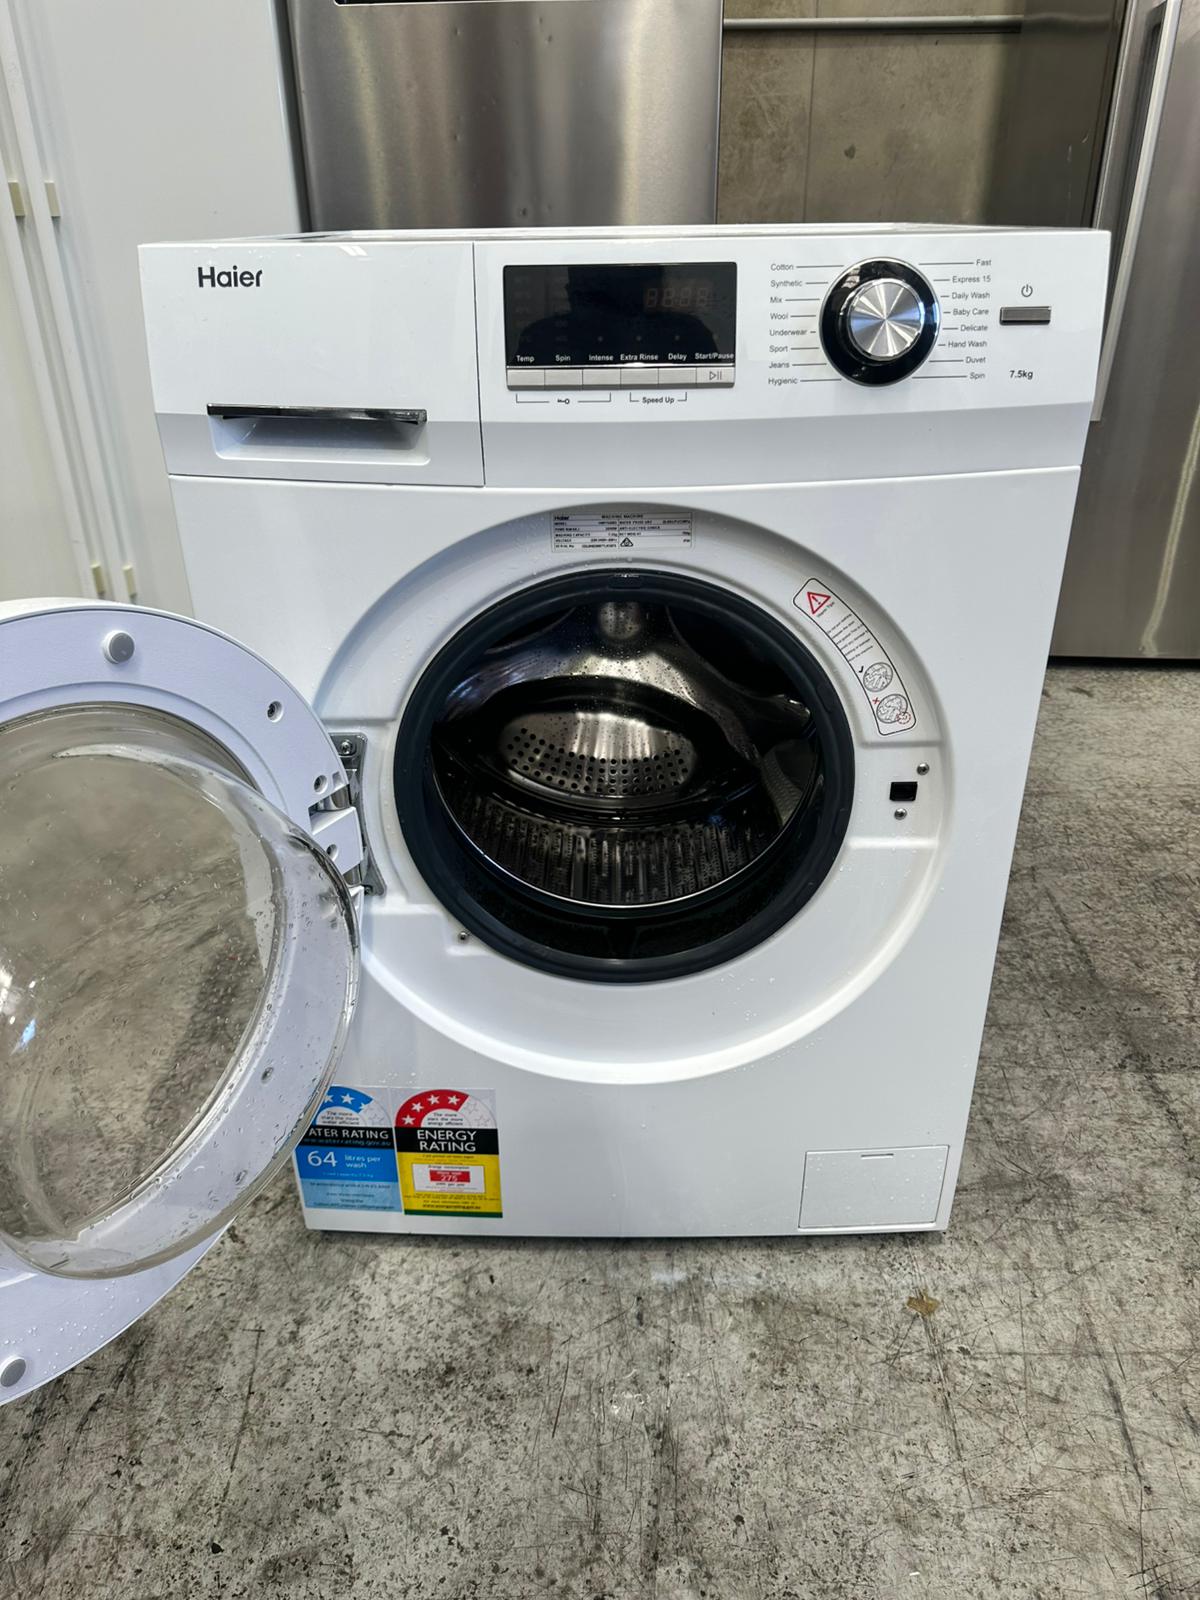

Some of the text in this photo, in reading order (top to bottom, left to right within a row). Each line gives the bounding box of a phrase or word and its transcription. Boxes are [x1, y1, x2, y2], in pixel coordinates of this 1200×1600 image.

[770, 263, 794, 271] Cotton
[976, 259, 992, 267] Fast
[197, 265, 263, 288] Haier
[952, 275, 991, 284] Express 15
[770, 279, 802, 288] Synthetic
[951, 291, 990, 300] Daily Wash
[770, 312, 788, 320] Wool
[952, 308, 989, 317] Baby Care
[769, 328, 807, 336] Underwear
[960, 324, 988, 332] Delicate
[769, 345, 788, 353] Sport
[947, 340, 987, 349] Hand Wash
[516, 352, 735, 363] Temp Spin Intense Extra Rinse Delay Start/Pause
[965, 356, 986, 364] Duvet
[768, 361, 790, 369] Jeans
[969, 372, 986, 381] Spin
[1009, 369, 1033, 380] 7.5kg
[768, 377, 798, 386] Hygienic
[642, 396, 675, 405] Speed Up
[309, 1127, 389, 1140] ATER RATING
[416, 1129, 477, 1141] ENERGY
[419, 1141, 476, 1152] RATING
[307, 1150, 338, 1168] 64
[367, 1155, 381, 1163] per
[345, 1161, 367, 1169] wash
